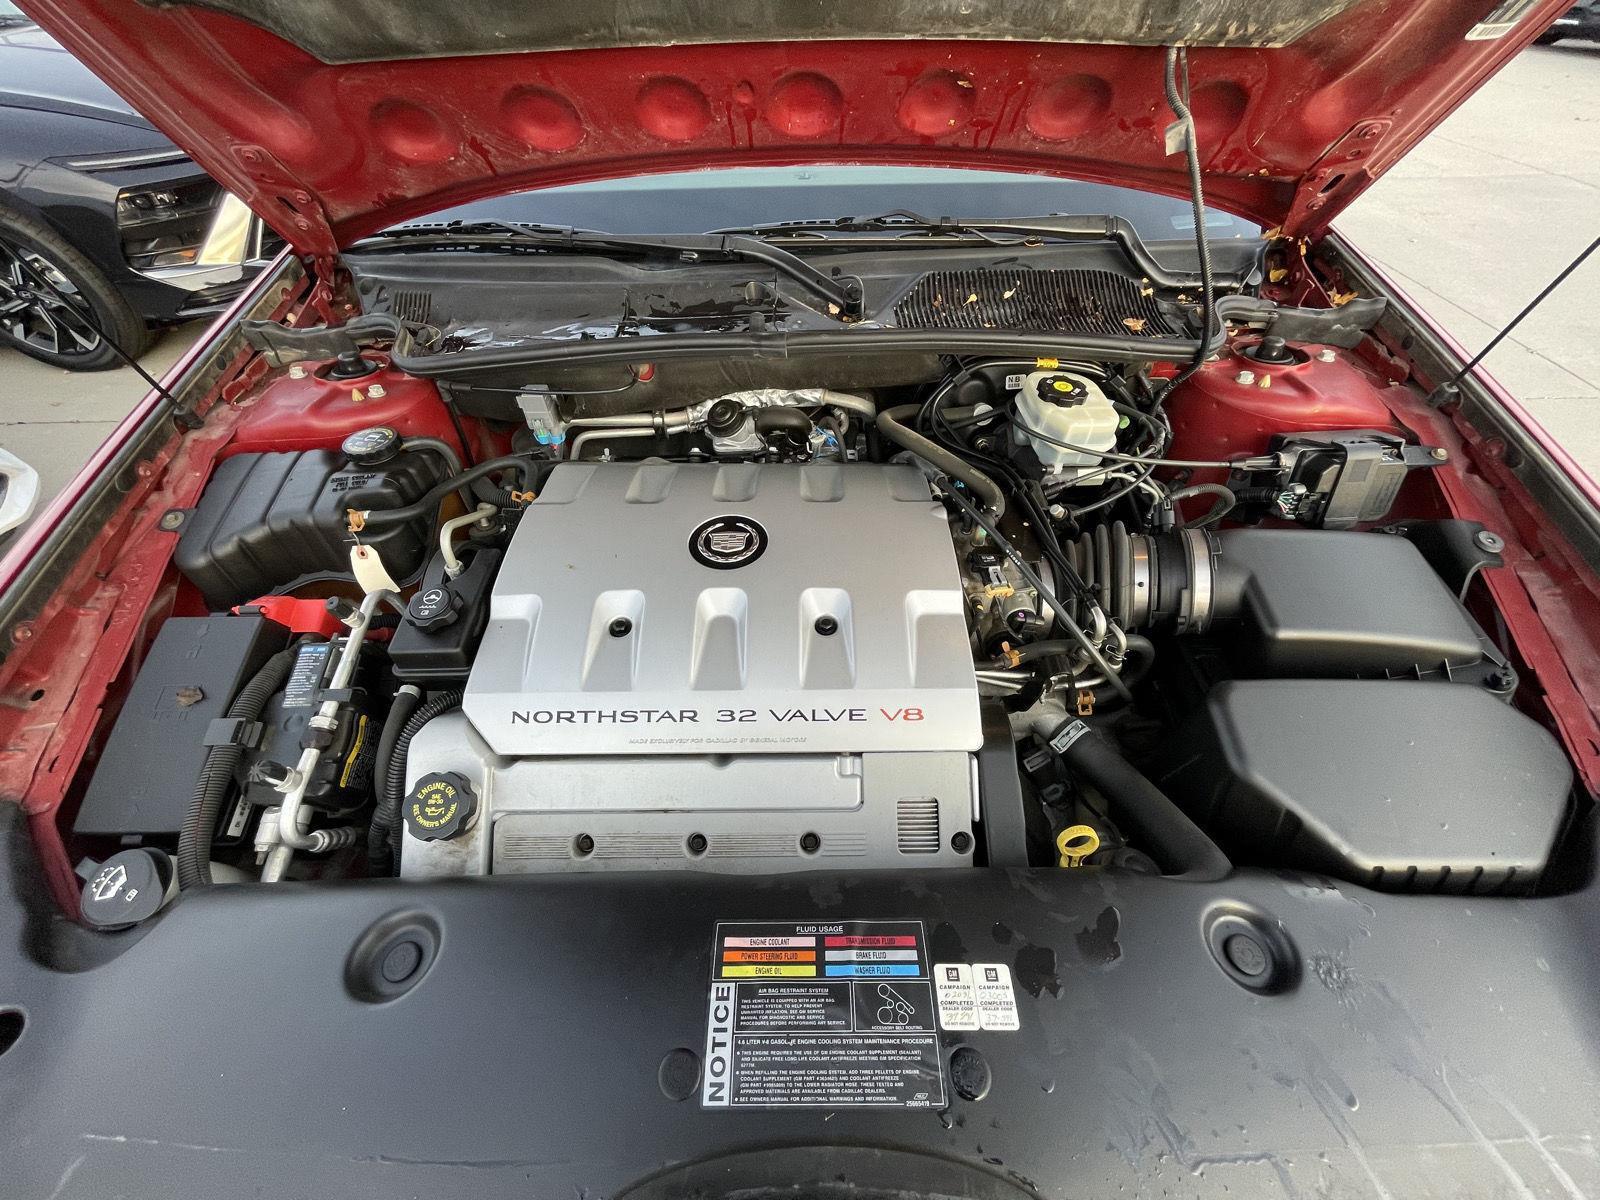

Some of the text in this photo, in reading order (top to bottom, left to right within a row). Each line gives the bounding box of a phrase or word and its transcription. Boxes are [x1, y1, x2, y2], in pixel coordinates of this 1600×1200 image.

[512, 708, 924, 724] NORTHSTAR 32 VALVE V8
[418, 782, 456, 799] ENGINE OIL
[440, 802, 457, 824] MANUAL
[754, 967, 782, 975] ENGINE OIL
[854, 966, 891, 974] WASHER FLUID
[708, 986, 731, 1102] NOTICE
